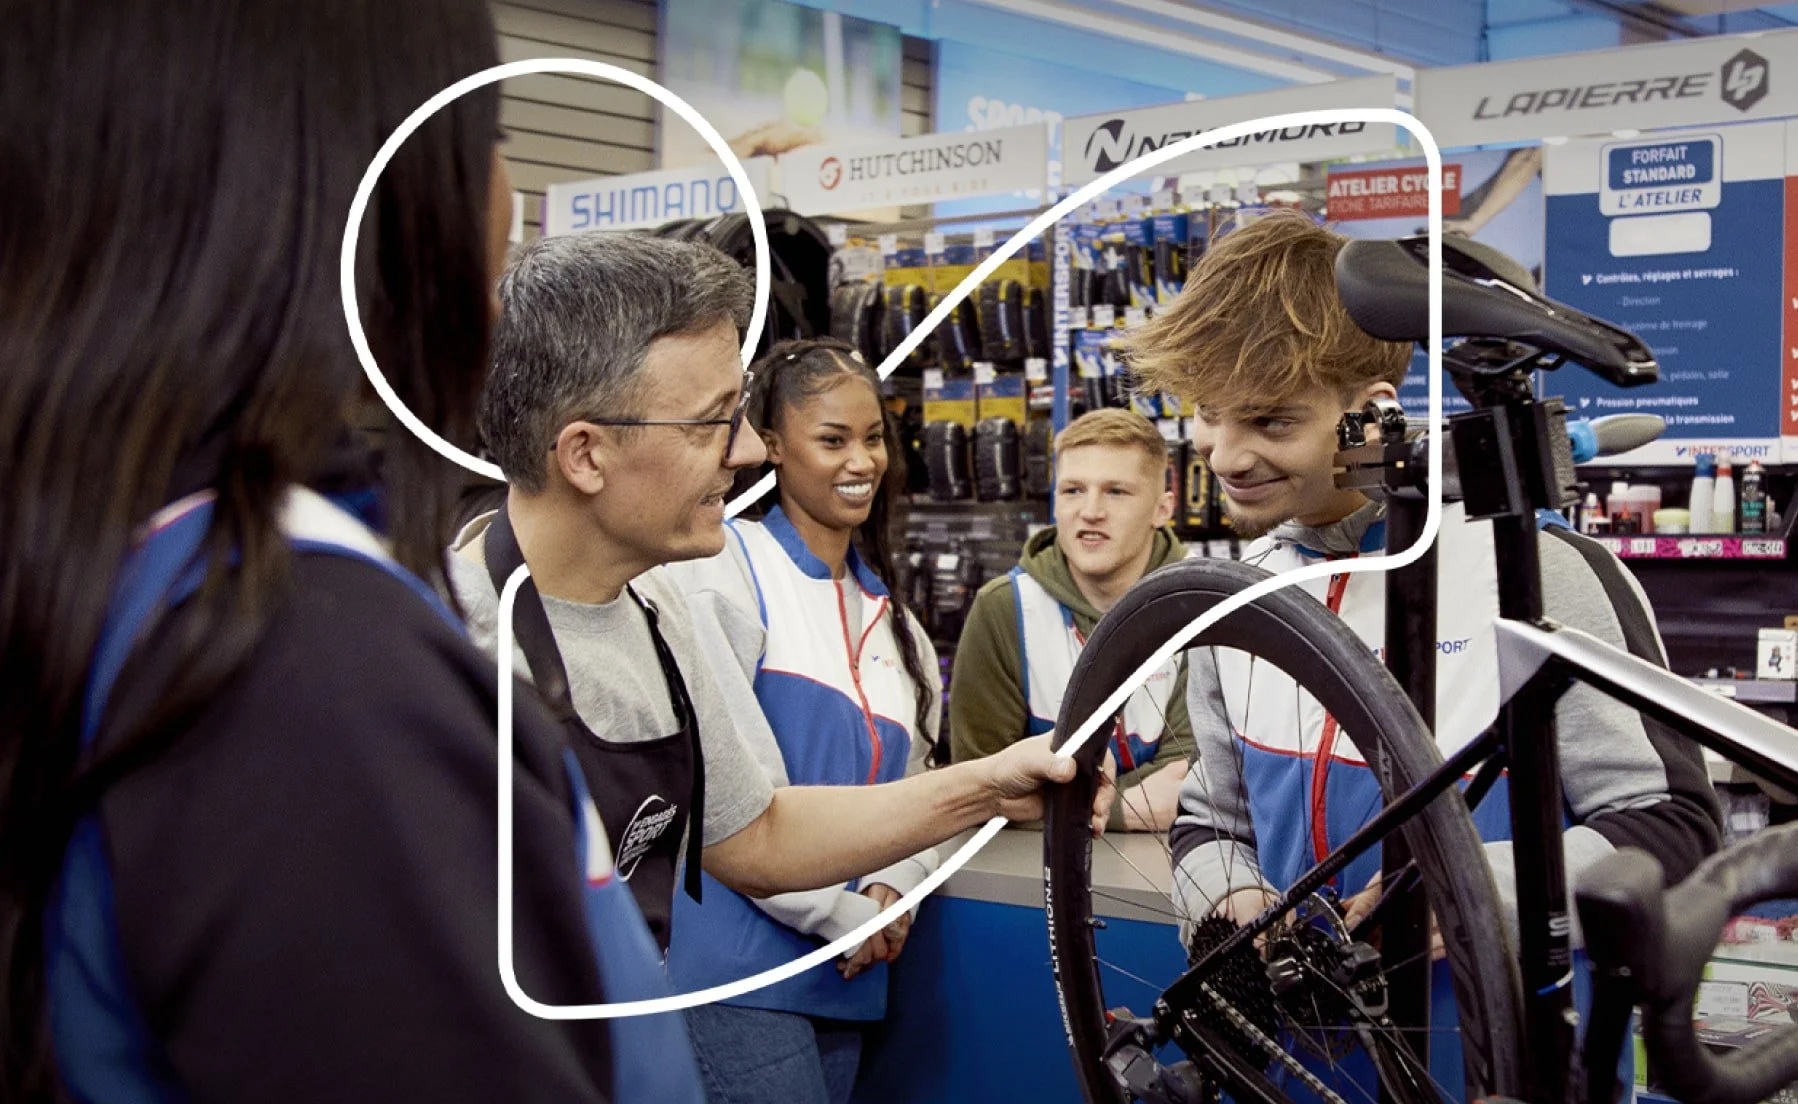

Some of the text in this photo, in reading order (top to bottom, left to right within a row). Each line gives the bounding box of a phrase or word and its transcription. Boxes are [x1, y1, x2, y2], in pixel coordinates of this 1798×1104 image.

[1473, 72, 1714, 120] LAPIERRE
[1137, 120, 1366, 157] NAAMURA
[849, 139, 1002, 181] HUTCHINSON
[1632, 145, 1688, 164] FORFAIT
[1330, 176, 1399, 197] ATELIER
[1623, 164, 1696, 184] STANDARD
[572, 177, 738, 228] SHIMANO
[1688, 446, 1770, 457] INTESPORT
